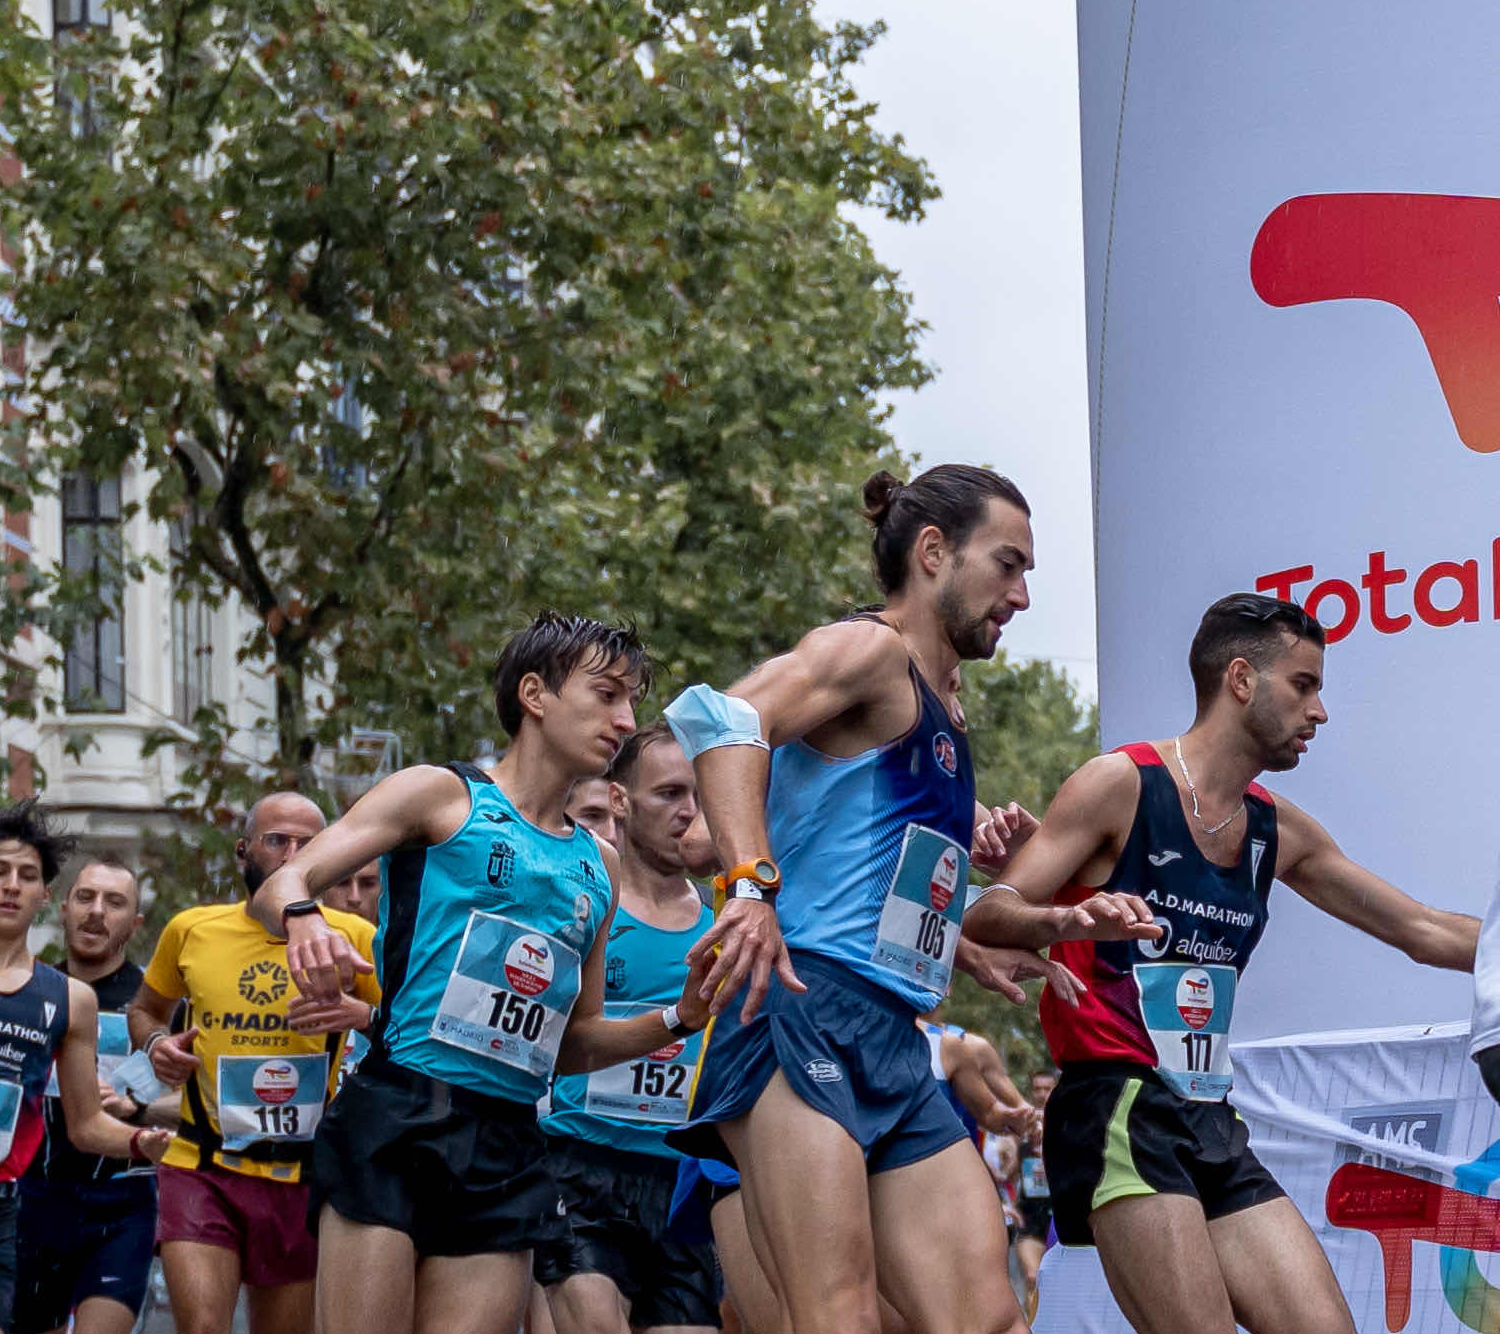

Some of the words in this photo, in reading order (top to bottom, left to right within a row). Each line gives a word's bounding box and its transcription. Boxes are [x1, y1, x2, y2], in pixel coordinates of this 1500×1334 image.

[915, 909, 948, 960] 105
[488, 990, 546, 1042] 150
[231, 1034, 290, 1047] SPORTS
[1181, 1032, 1212, 1073] 177
[630, 1061, 687, 1099] 152
[254, 1105, 299, 1136] 113
